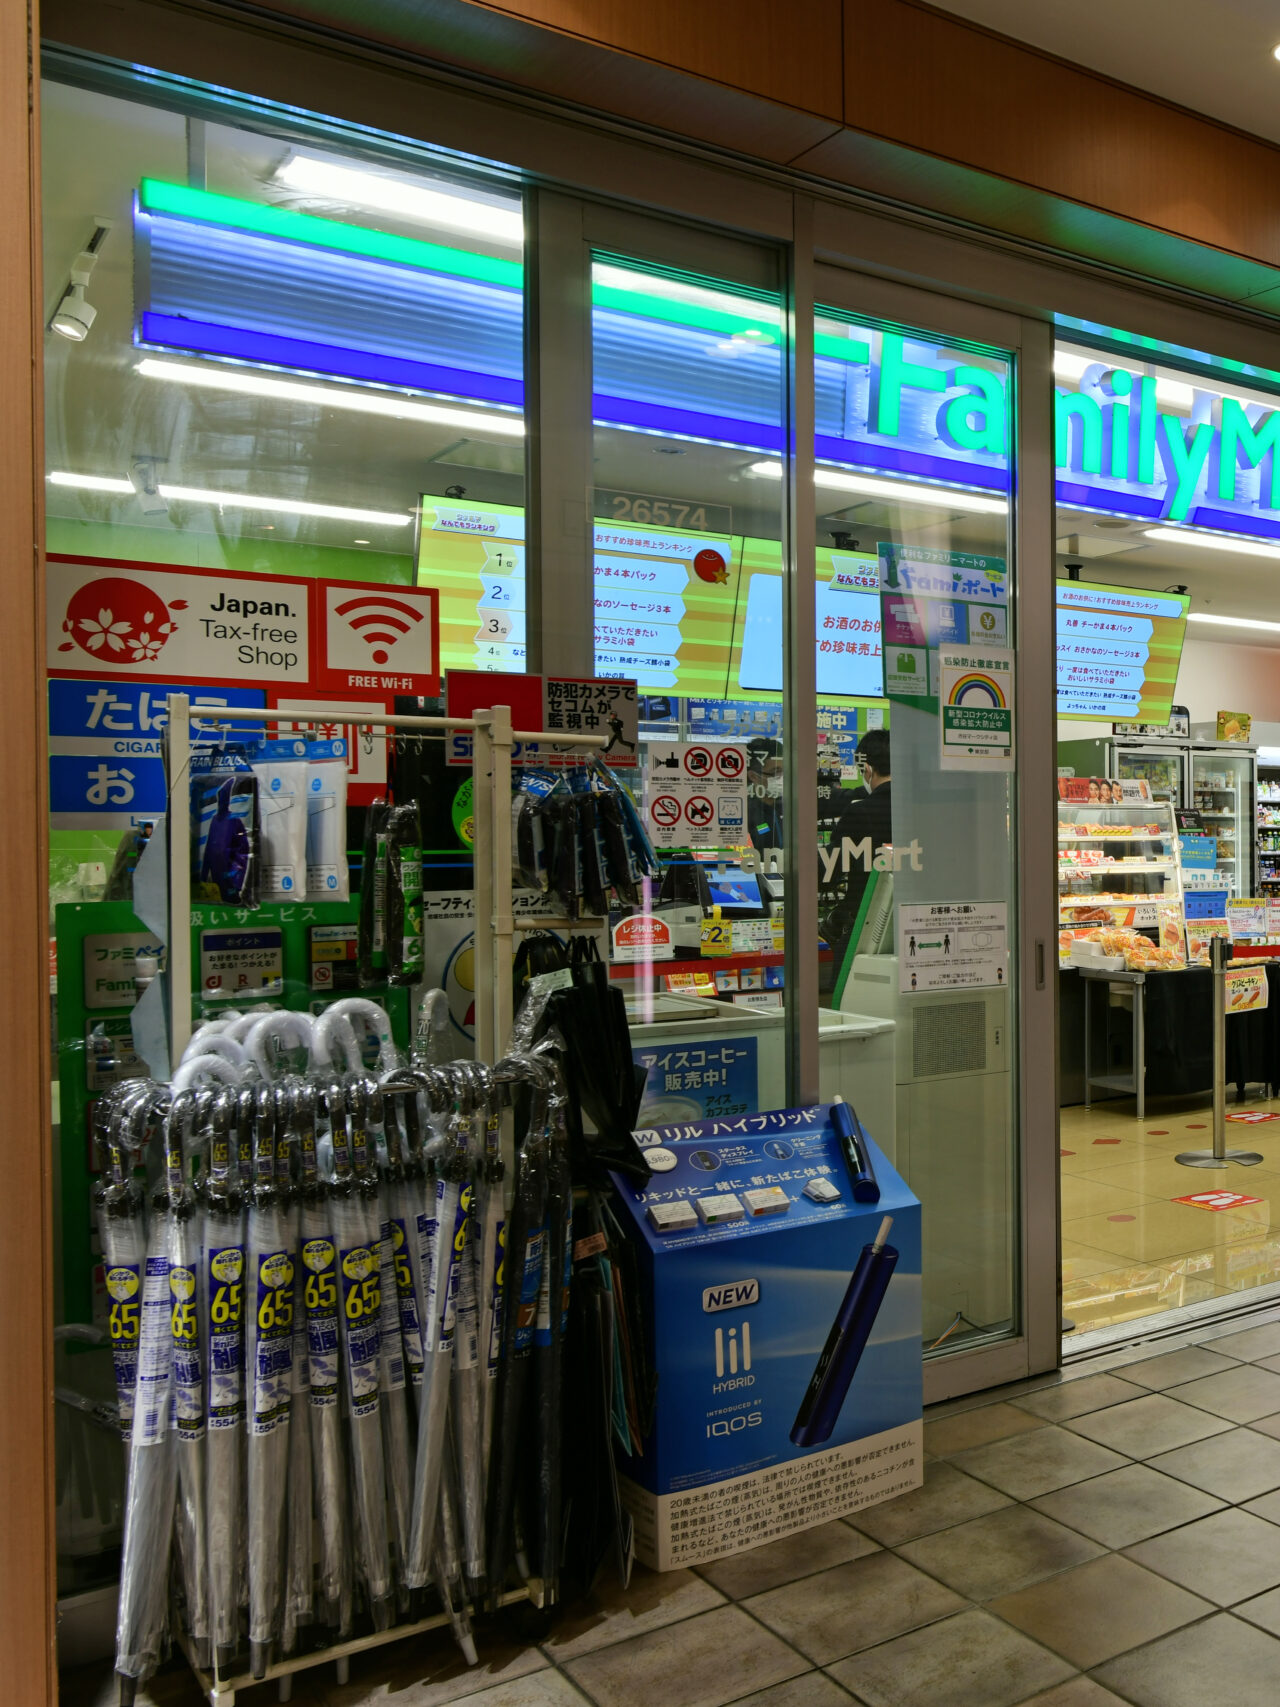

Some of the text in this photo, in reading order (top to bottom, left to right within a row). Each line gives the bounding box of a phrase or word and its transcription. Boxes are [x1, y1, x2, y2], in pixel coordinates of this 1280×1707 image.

[612, 496, 709, 532] 26574
[210, 592, 297, 621] Japan.
[200, 619, 298, 644] Tax-free
[237, 645, 298, 671] Shop
[348, 674, 413, 690] FREE Wi-Fi
[548, 682, 635, 701] 防犯カメラで
[548, 699, 612, 714] セコムが
[548, 713, 600, 729] 監視中
[718, 836, 923, 883] FamyMart
[930, 905, 976, 914] お客様へお願い
[622, 923, 662, 934] レジ休止中
[95, 945, 165, 961] ファミペイ
[226, 936, 262, 946] ポイント
[208, 951, 278, 962] お好きなポイントが
[641, 1047, 748, 1071] アイスコーヒー
[664, 1068, 727, 1092] 販売中!
[705, 1093, 732, 1107] アイス
[705, 1104, 748, 1117] カフェラテ
[665, 1109, 818, 1142] リル ハイブリッド
[304, 1271, 337, 1308] 65
[345, 1276, 381, 1319] 65
[707, 1283, 756, 1309] NEW
[211, 1283, 242, 1324] 65
[258, 1288, 294, 1330] 65
[109, 1302, 140, 1340] 65
[171, 1302, 199, 1340] 65
[715, 1321, 751, 1378] lil
[713, 1375, 756, 1395] HYBRID
[706, 1401, 752, 1417] INTRODUCED
[706, 1411, 763, 1439] IQOS
